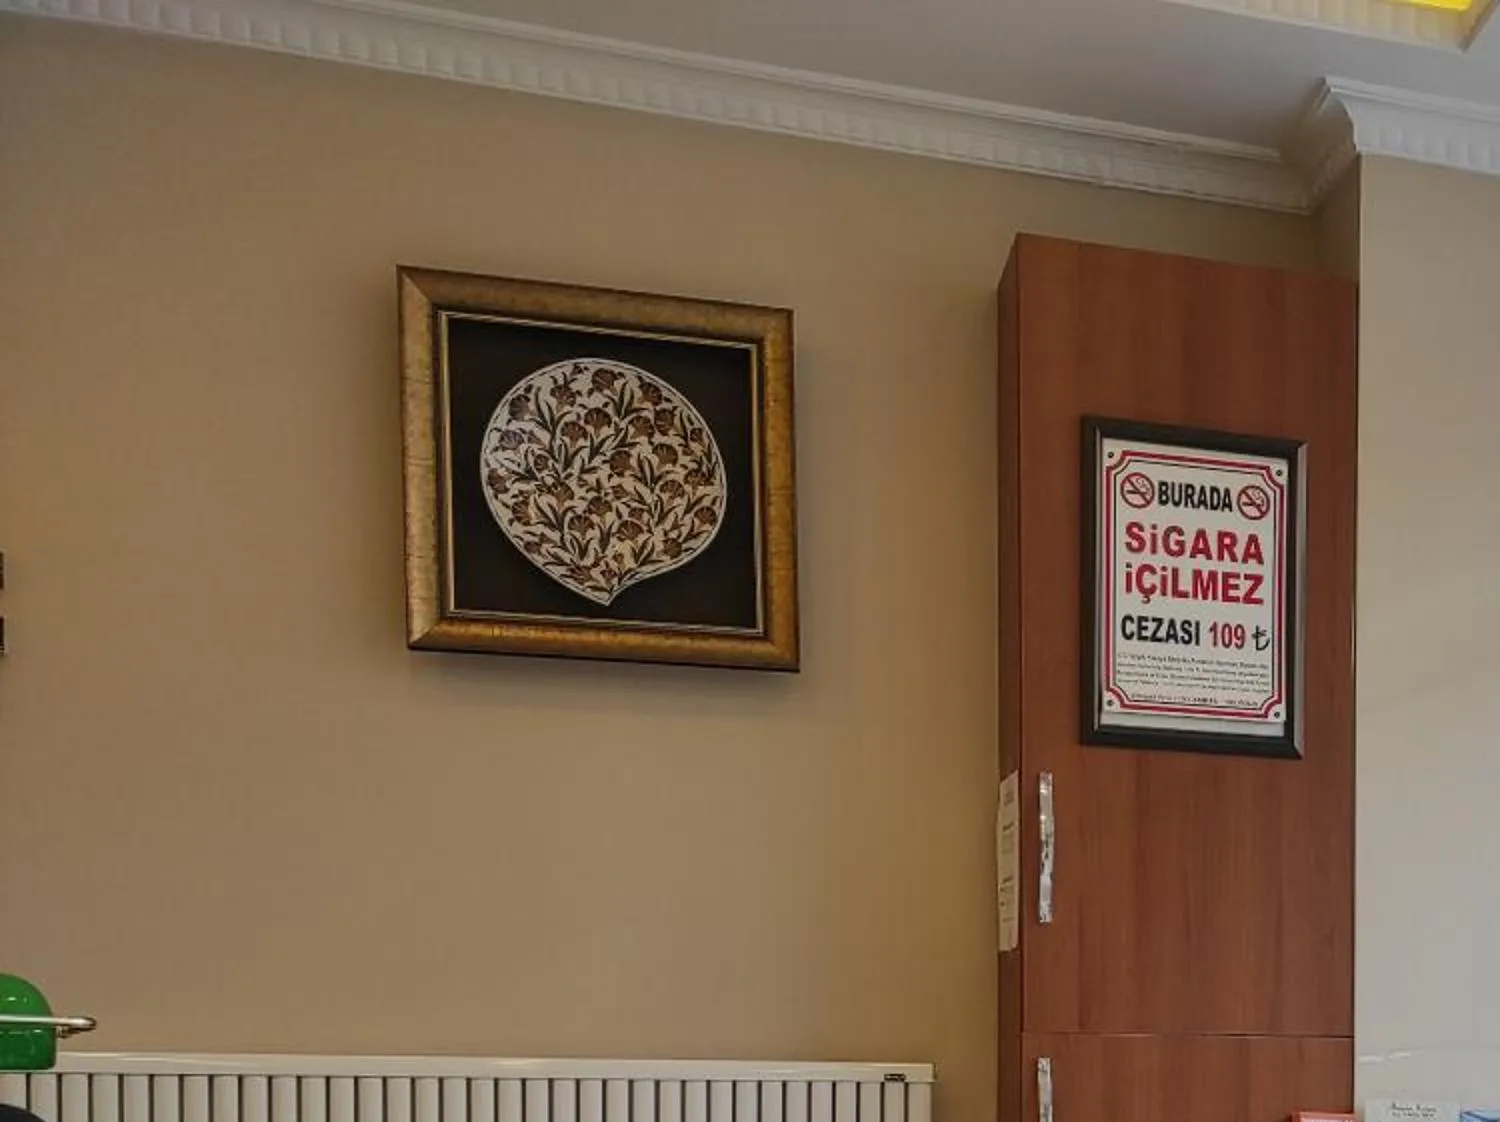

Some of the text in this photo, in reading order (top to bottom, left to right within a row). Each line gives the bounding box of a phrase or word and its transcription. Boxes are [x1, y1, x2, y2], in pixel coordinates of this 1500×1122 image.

[1157, 480, 1233, 512] BURADA
[1121, 614, 1200, 646] CEZASI
[1209, 621, 1246, 650] 109
